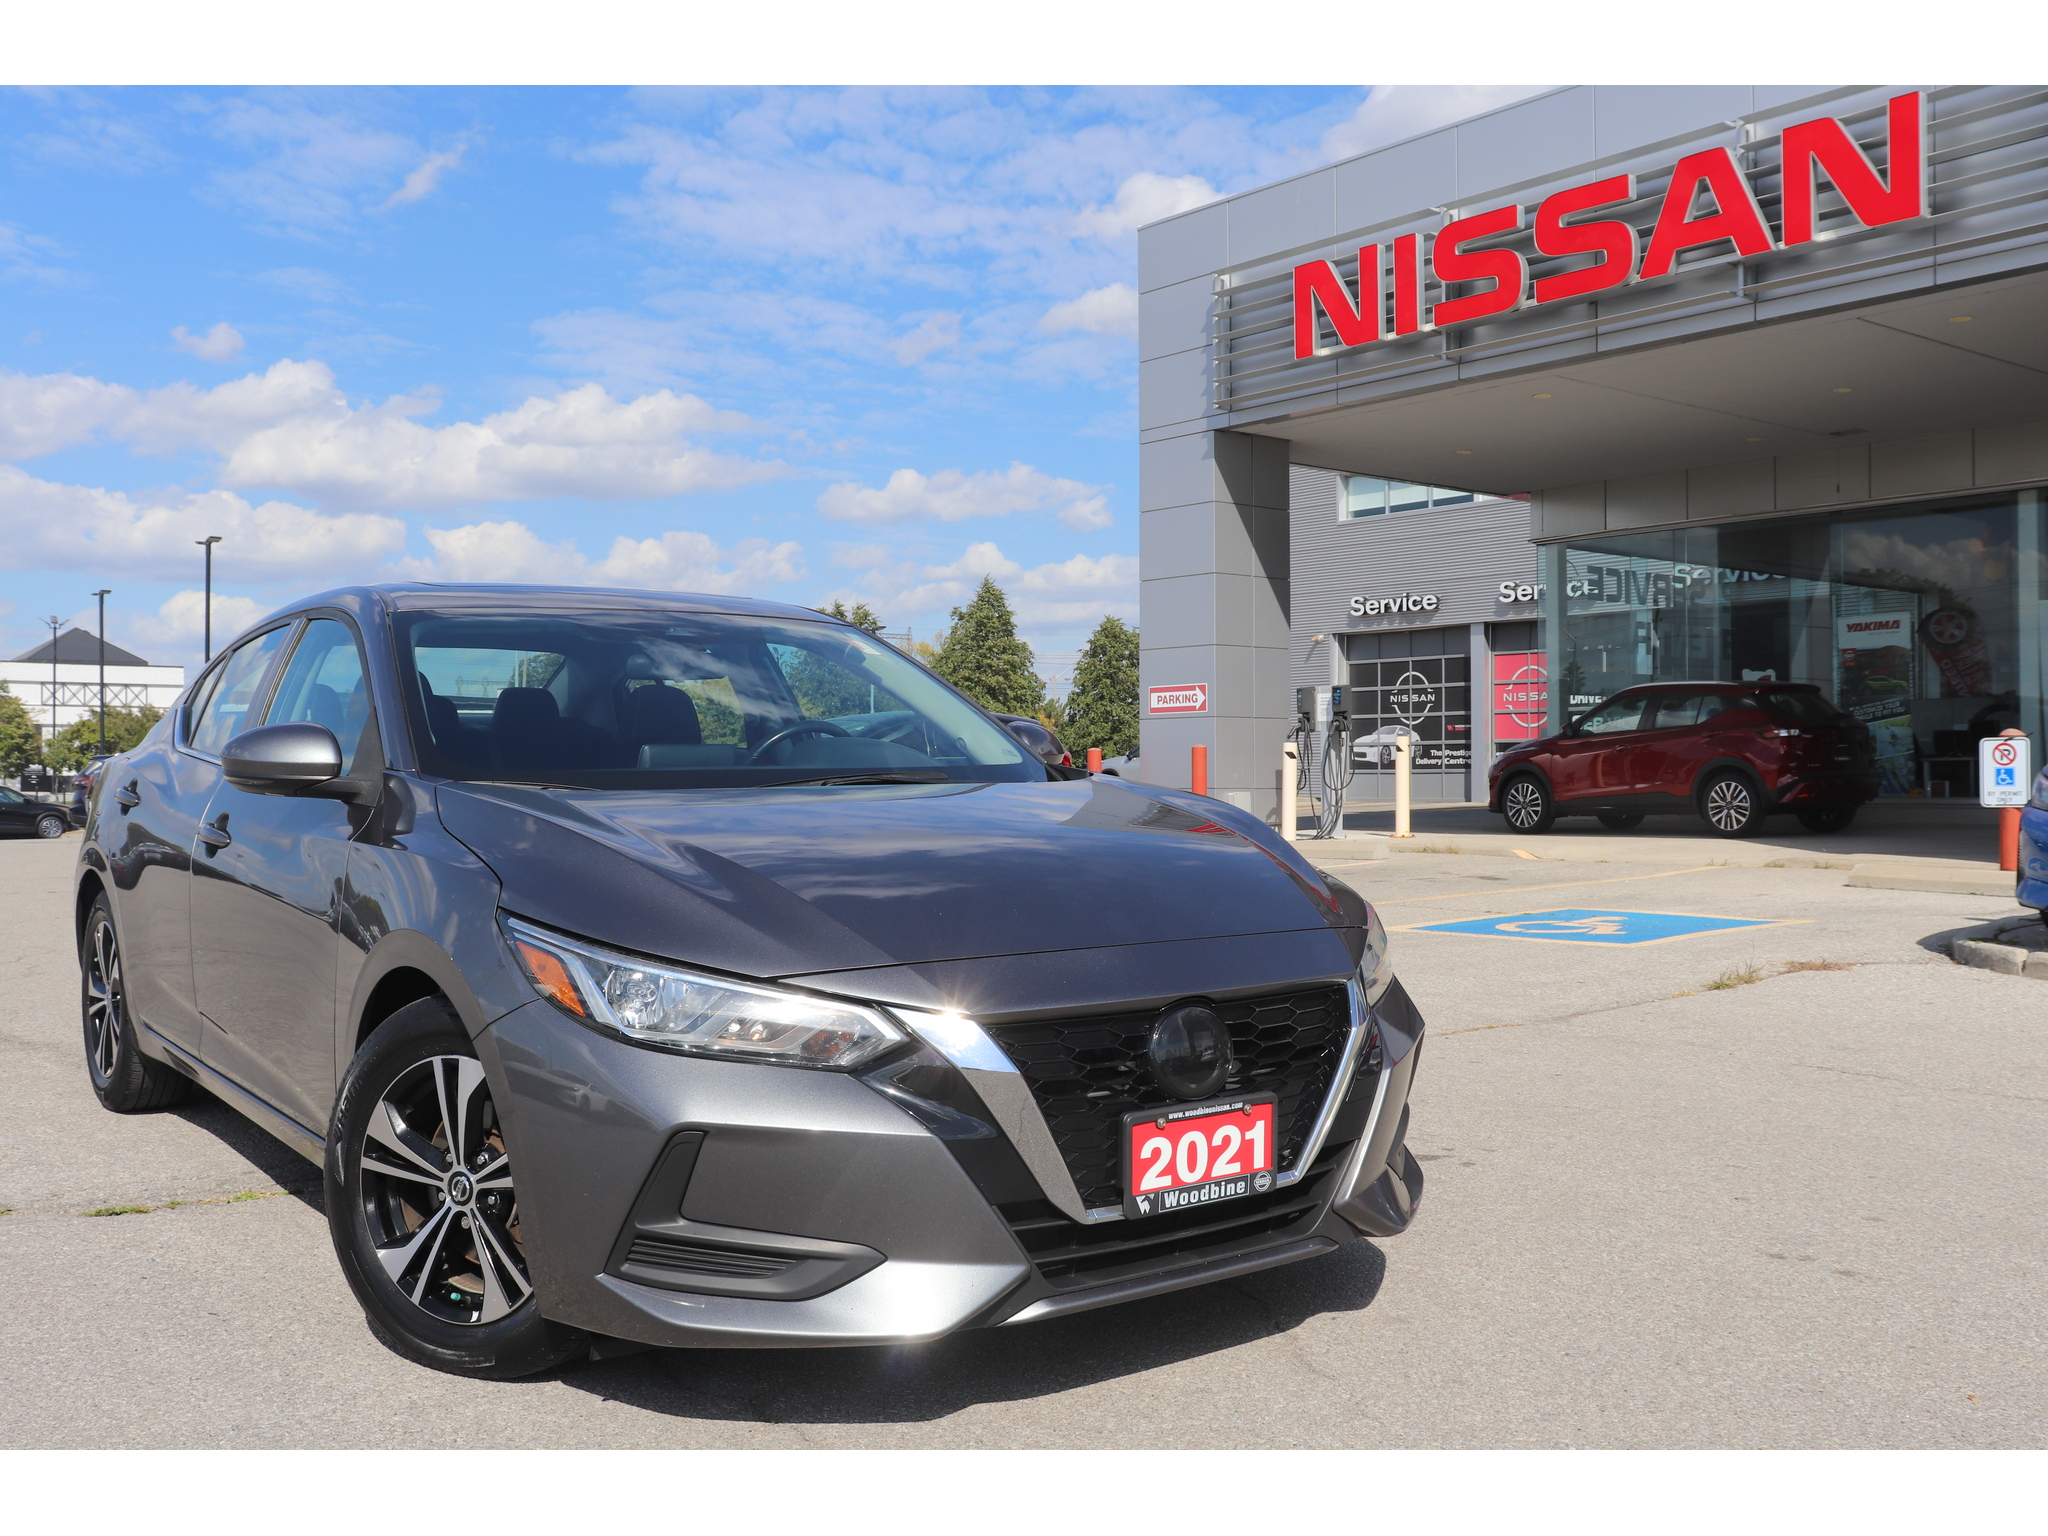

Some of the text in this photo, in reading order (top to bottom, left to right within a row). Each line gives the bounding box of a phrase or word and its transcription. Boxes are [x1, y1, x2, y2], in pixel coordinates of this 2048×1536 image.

[1292, 91, 1928, 361] NISSAN
[1498, 580, 1599, 602] Serce
[1350, 593, 1438, 616] Service
[1846, 620, 1900, 632] YAKIMA
[1157, 693, 1198, 705] PARKING
[1390, 694, 1435, 703] NISSAN
[1503, 691, 1548, 702] NISSA
[1884, 701, 1901, 710] YOUR
[1168, 1102, 1243, 1119] www.woodbinenissan.com
[1140, 1120, 1265, 1191] 2021
[1164, 1180, 1246, 1208] Woodbine
